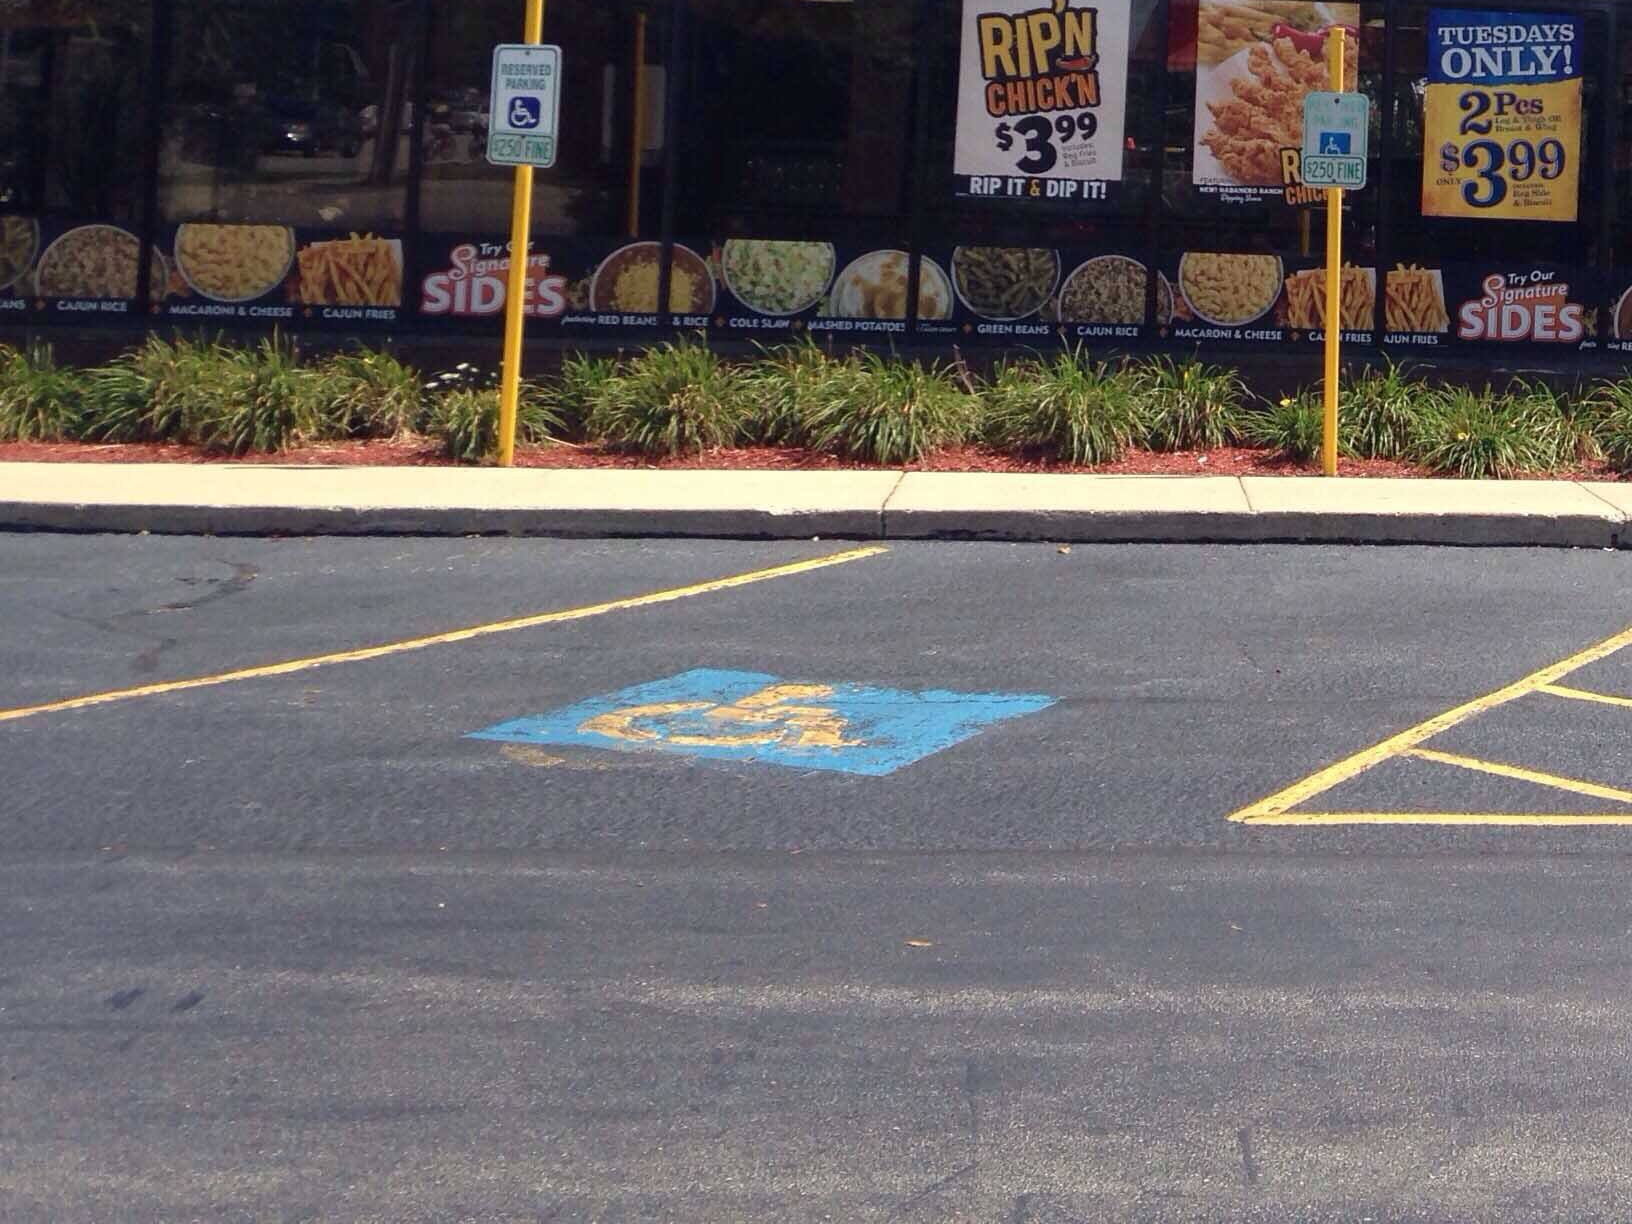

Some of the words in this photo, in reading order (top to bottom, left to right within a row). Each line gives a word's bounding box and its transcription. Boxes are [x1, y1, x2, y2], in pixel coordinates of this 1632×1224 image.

[1438, 24, 1575, 45] TUESDAYS
[1441, 44, 1574, 78] ONLY!
[501, 63, 551, 76] RESERVED
[505, 78, 545, 90] PARKING
[987, 73, 1097, 116] CHICK'N
[1459, 90, 1493, 136] 2
[1493, 93, 1544, 116] Pcs
[525, 140, 550, 160] FINE
[1306, 161, 1333, 178] $250
[1337, 163, 1361, 180] FINE
[969, 177, 1001, 195] RIP
[1007, 178, 1025, 196] IT
[1029, 178, 1040, 196] &
[1046, 180, 1077, 197] DIP
[1082, 181, 1106, 199] IT!
[480, 243, 502, 256] Try
[1508, 273, 1527, 286] Try
[1530, 270, 1555, 282] Our
[1481, 274, 1568, 308] Signature
[57, 299, 97, 311] CAJUN
[101, 301, 128, 312] RICE
[169, 305, 235, 316] MACARONI
[239, 306, 246, 316] &
[249, 307, 292, 317] CHEESE
[322, 308, 362, 319] CAJUN
[365, 309, 397, 320] FRIES
[598, 315, 620, 325] RED
[672, 316, 681, 325] &
[683, 317, 709, 326] RICE
[729, 318, 758, 327] COLE
[761, 318, 790, 328] SLAW
[808, 320, 852, 331] MASHED
[1459, 303, 1583, 340] SIDES
[977, 324, 1012, 334] GREEN
[1015, 325, 1049, 335] BEANS
[1077, 326, 1112, 336] CAJUN
[1115, 327, 1139, 337] RICE
[1175, 328, 1232, 339] MACARONI
[1234, 328, 1241, 339] &
[1244, 329, 1282, 340] CHEESE
[1345, 333, 1372, 343] FRIES
[1412, 335, 1438, 345] FRIES
